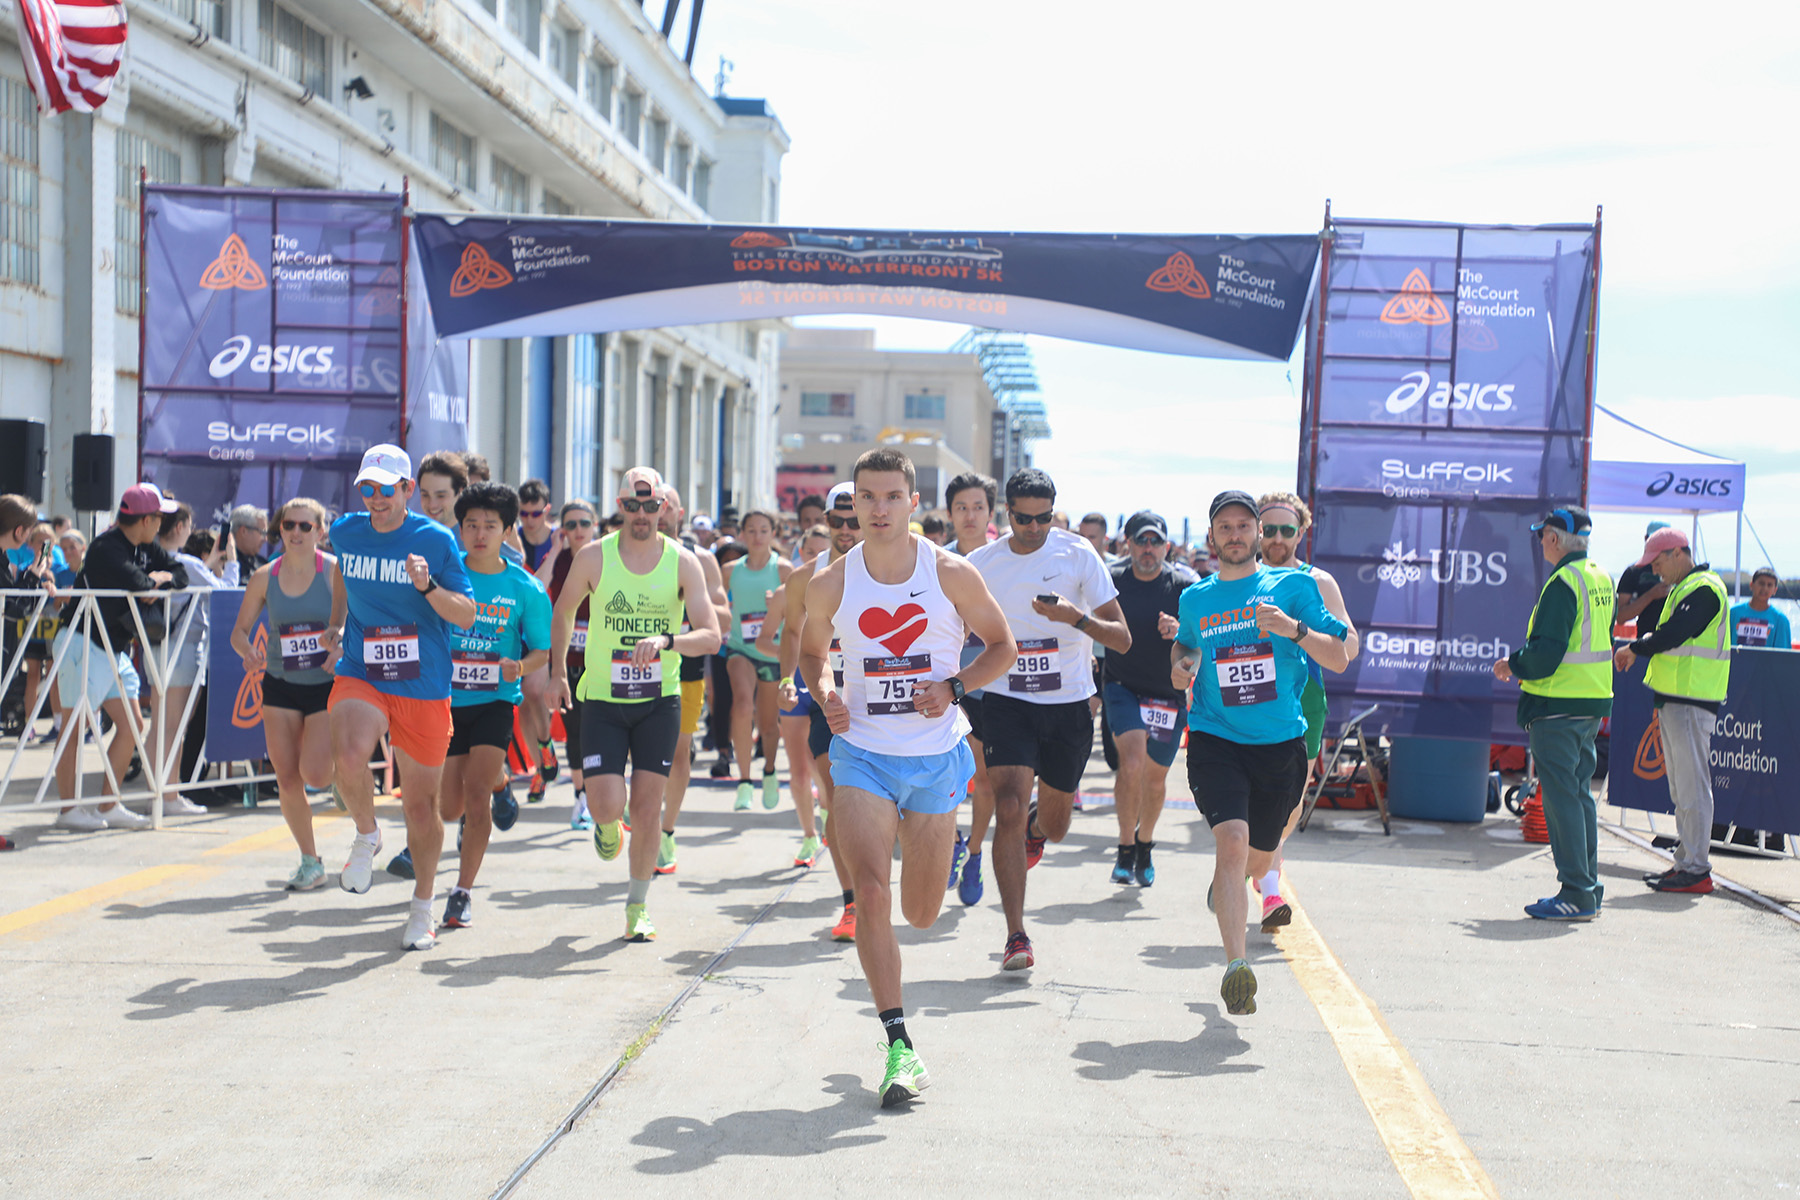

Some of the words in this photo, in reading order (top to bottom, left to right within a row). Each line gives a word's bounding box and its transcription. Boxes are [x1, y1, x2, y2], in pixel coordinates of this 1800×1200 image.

[272, 234, 298, 249] The
[508, 235, 535, 247] The
[272, 251, 333, 266] McCourt
[512, 245, 572, 260] McCourt
[514, 254, 591, 273] Foundation
[1219, 254, 1245, 268] The
[272, 266, 349, 281] Foundation
[733, 259, 821, 272] BOSTON
[826, 260, 971, 279] WATERFRONT
[976, 268, 1003, 282] 5K
[1218, 266, 1276, 291] McCourt
[1457, 268, 1483, 283] The
[1216, 281, 1286, 310] Foundation
[1457, 285, 1519, 301] McCourt
[1456, 301, 1536, 317] Foundation
[208, 421, 336, 444] Suffolk
[208, 445, 255, 461] Cares
[1382, 459, 1513, 483] Suffolk
[1383, 483, 1430, 499] Cares
[342, 552, 377, 581] TEAM
[1429, 549, 1507, 586] UBS
[605, 615, 670, 633] PIONEERS
[1200, 605, 1261, 631] BOSTO
[1201, 619, 1256, 639] WATERFRONT
[290, 637, 318, 653] 349
[374, 644, 408, 660] 386
[461, 639, 492, 651] 2022
[1366, 631, 1511, 659] Genentech
[1017, 656, 1050, 672] 998
[1367, 657, 1376, 667] A
[1378, 658, 1418, 670] Member
[1419, 660, 1432, 672] of
[1432, 660, 1446, 671] the
[1449, 661, 1477, 673] Roche
[459, 667, 489, 680] 642
[621, 667, 652, 680] 996
[1229, 663, 1265, 683] 255
[879, 678, 917, 699] 757
[1147, 710, 1168, 725] 398
[1709, 744, 1778, 774] oundation
[1714, 775, 1730, 789] 1992
